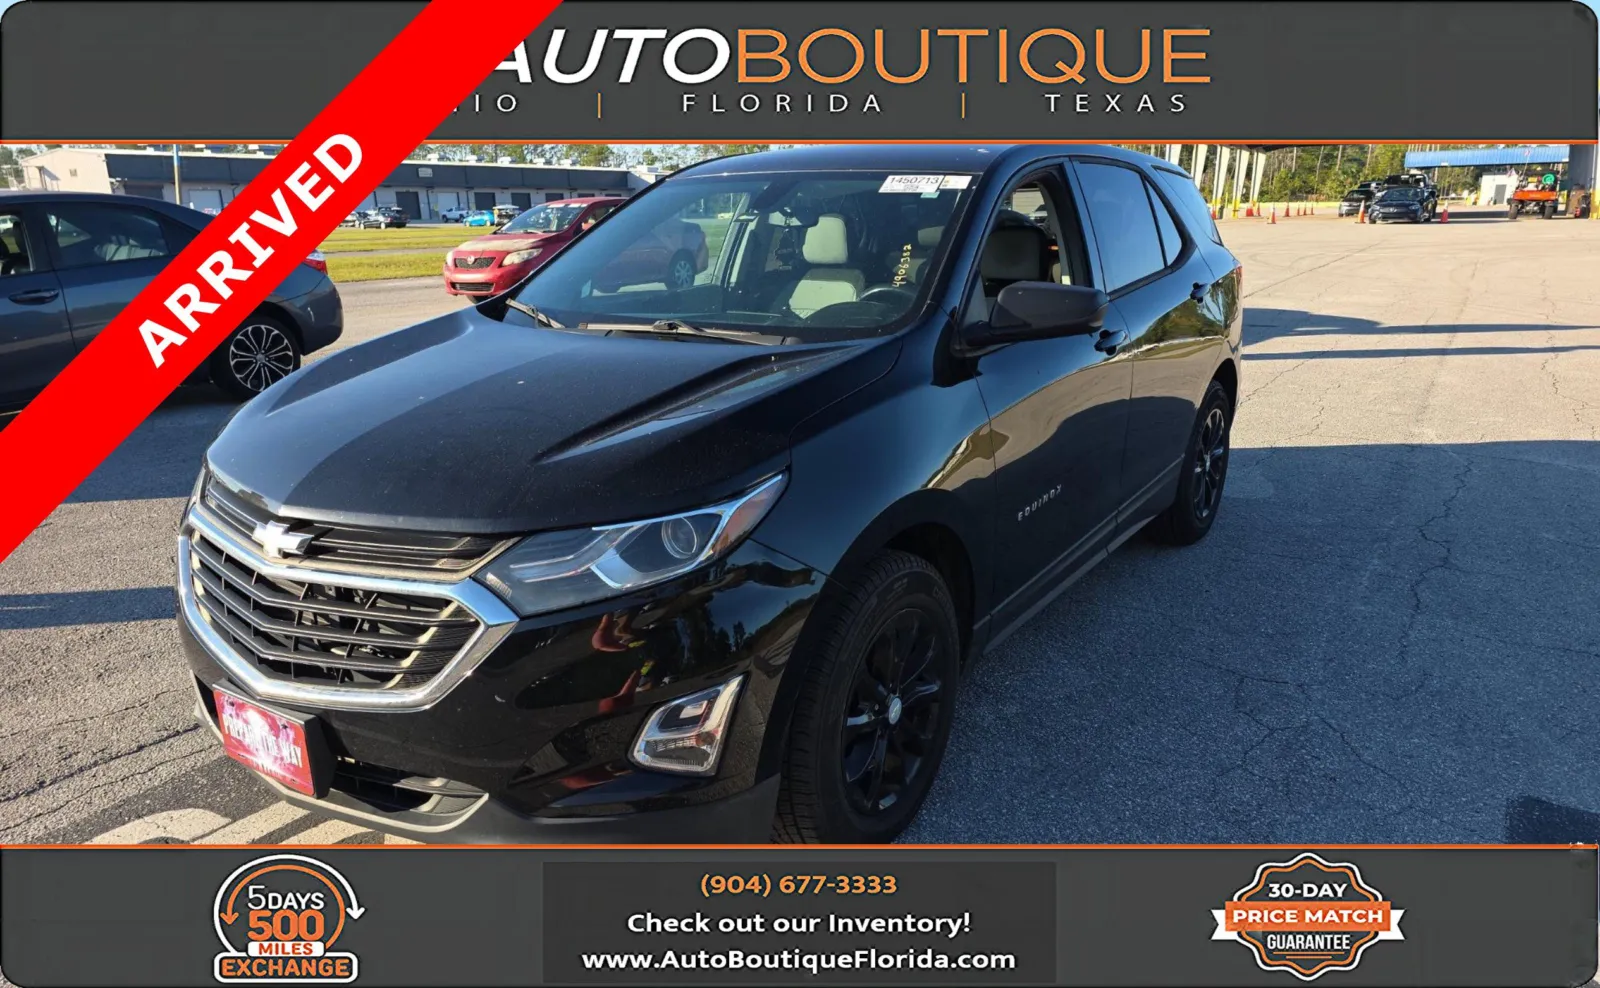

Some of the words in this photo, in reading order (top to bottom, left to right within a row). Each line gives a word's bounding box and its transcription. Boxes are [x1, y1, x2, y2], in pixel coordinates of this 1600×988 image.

[889, 176, 940, 185] 1450713
[892, 244, 912, 287] 4906382
[1017, 483, 1062, 521] EQUINOX
